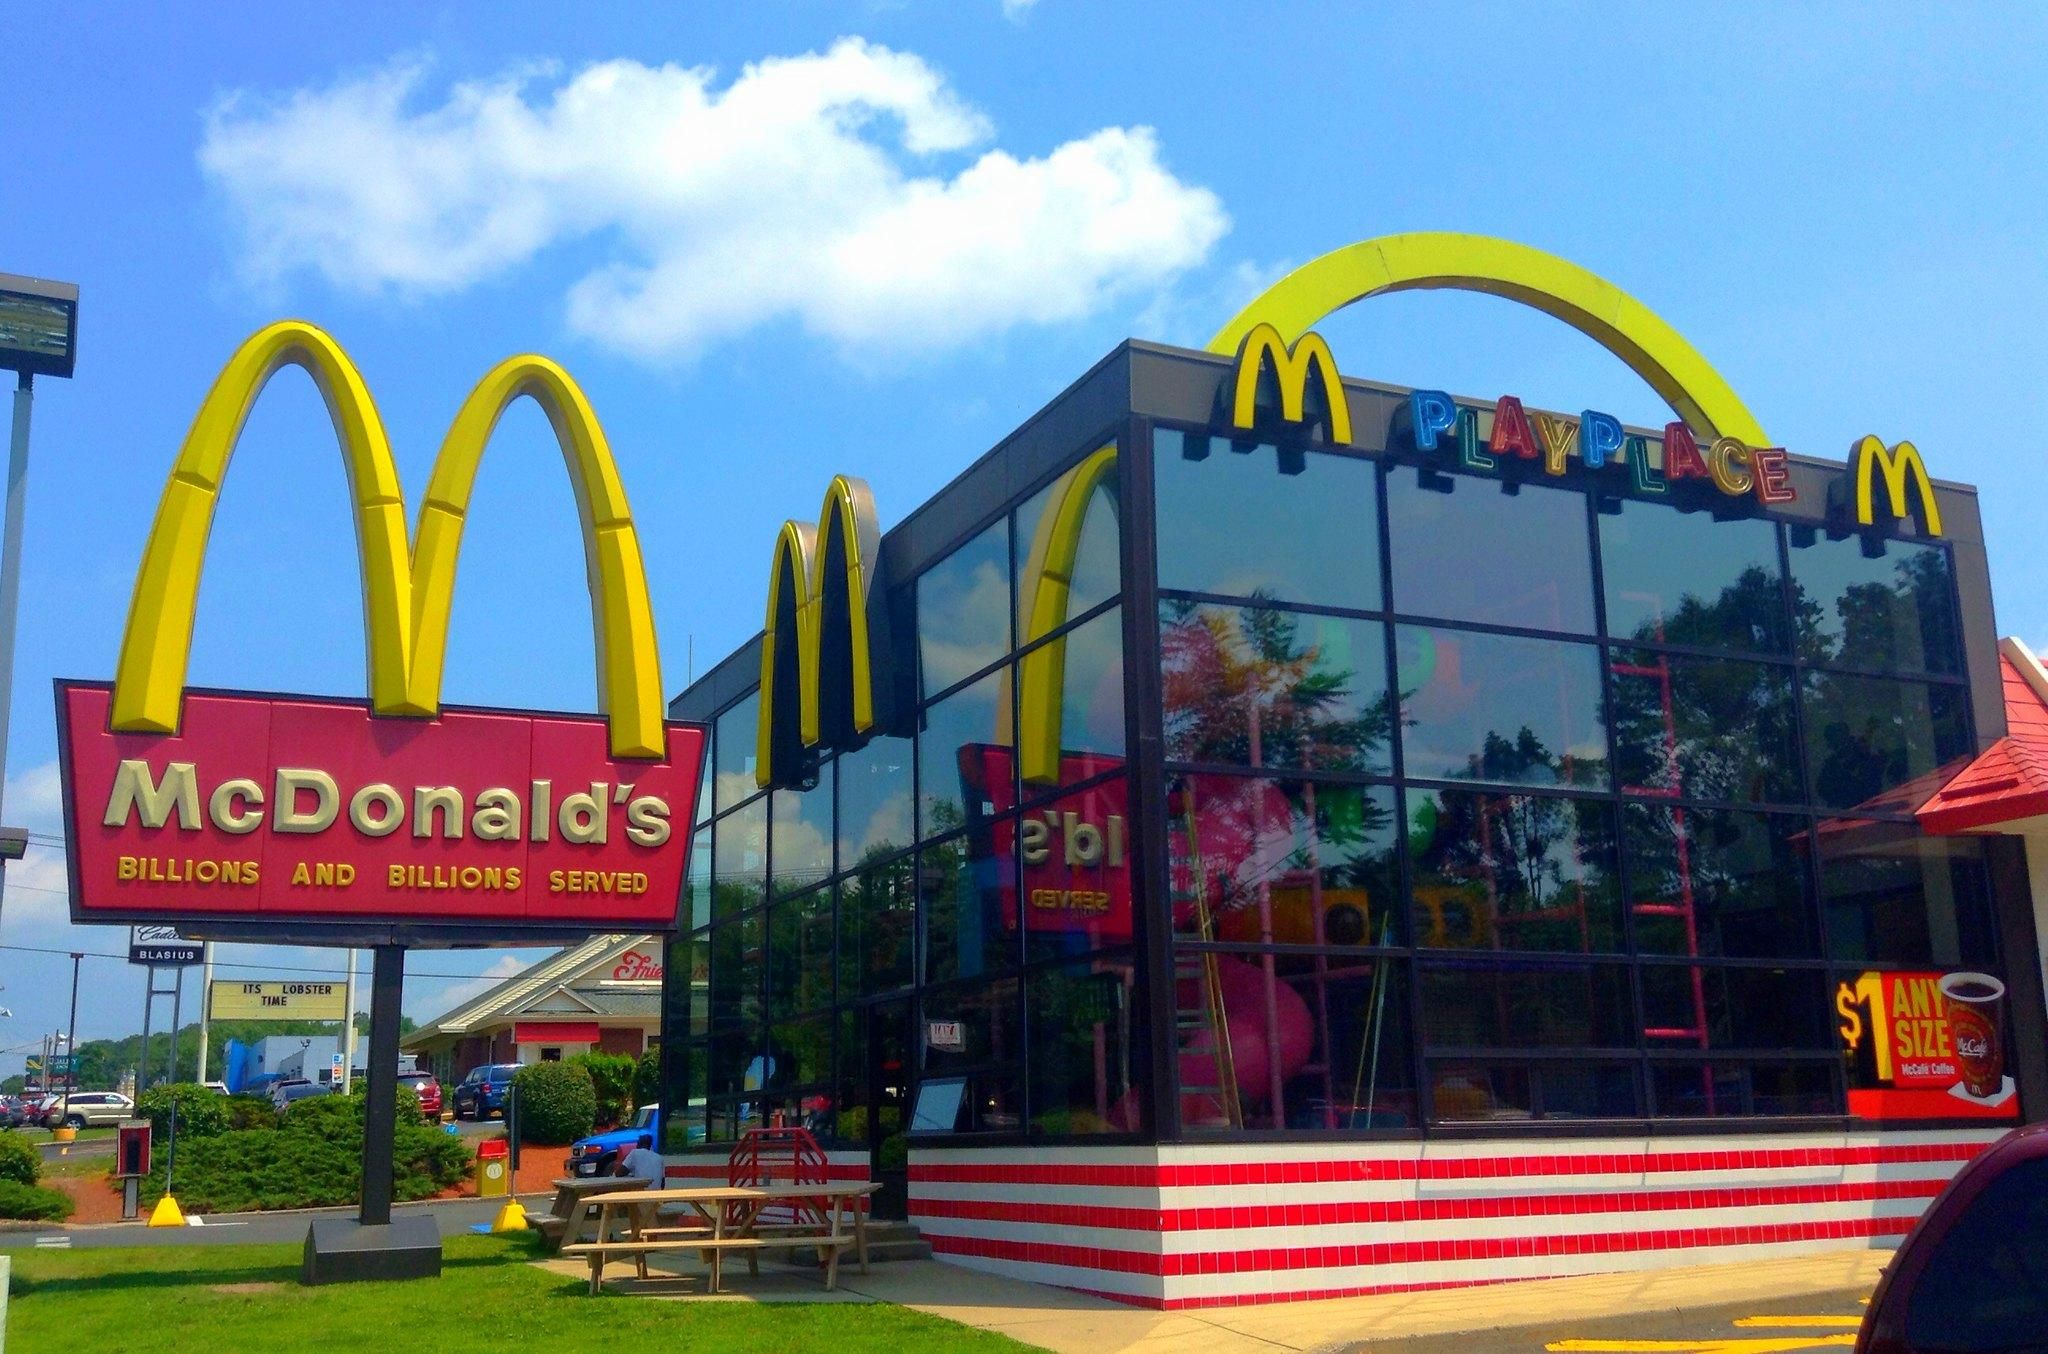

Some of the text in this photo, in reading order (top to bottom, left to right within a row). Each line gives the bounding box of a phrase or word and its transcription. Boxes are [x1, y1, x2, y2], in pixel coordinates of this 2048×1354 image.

[1409, 389, 1797, 504] PLAYPLACE
[104, 760, 671, 848] McDonald's
[118, 857, 649, 895] BILLIONS AND BILLIONS SERVED
[139, 950, 194, 960] BLASIUS
[243, 984, 332, 995] ITS LOBSTER
[261, 996, 287, 1006] TIME
[1893, 978, 1945, 1018] ANY
[1836, 971, 1894, 1081] $1
[1895, 1019, 1952, 1059] SIZE
[1931, 1063, 1956, 1075] Coffee
